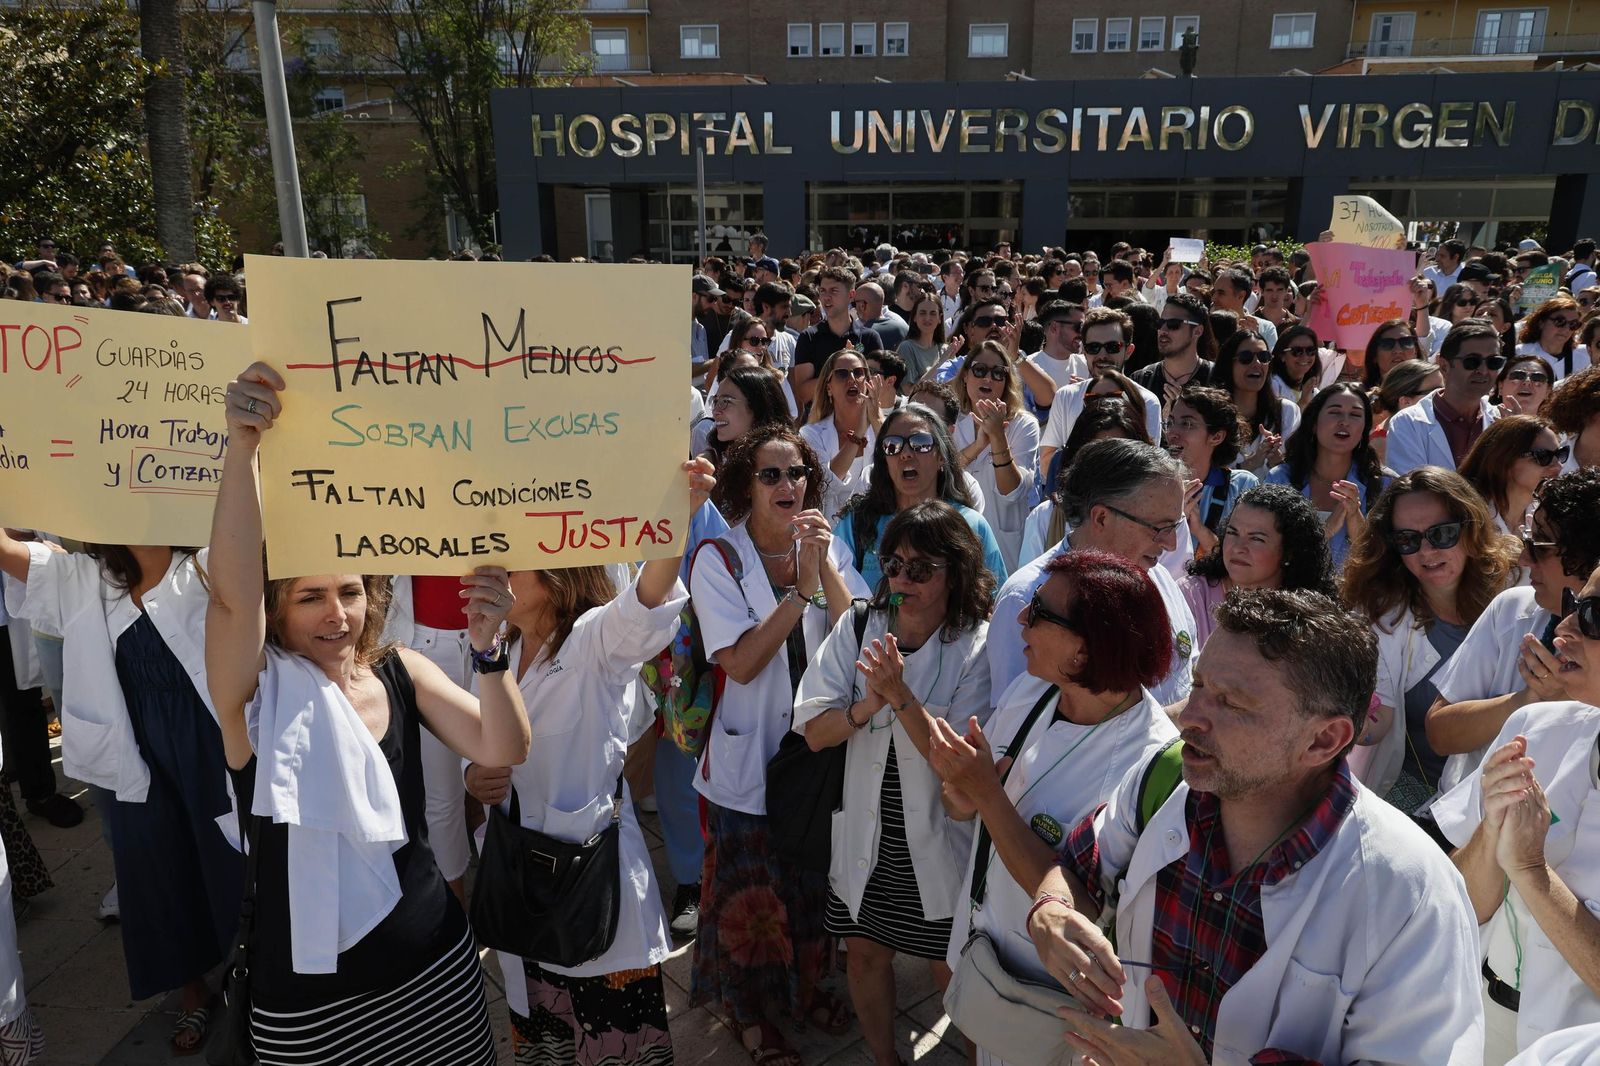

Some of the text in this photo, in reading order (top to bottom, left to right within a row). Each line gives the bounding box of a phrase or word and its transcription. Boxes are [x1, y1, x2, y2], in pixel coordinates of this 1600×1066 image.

[531, 99, 1600, 158] HOSPITAL UNIVERSITARIO VIRGEN D
[1339, 200, 1360, 222] 37
[326, 297, 623, 392] FALTAN MEDICOS
[117, 380, 226, 405] 24 HORAS
[100, 418, 149, 444] Hora
[328, 404, 620, 451] SOBRAN EXCUSAS
[104, 462, 121, 487] y
[291, 469, 425, 509] FALTAN
[335, 511, 673, 558] LABORALES JUSTAS
